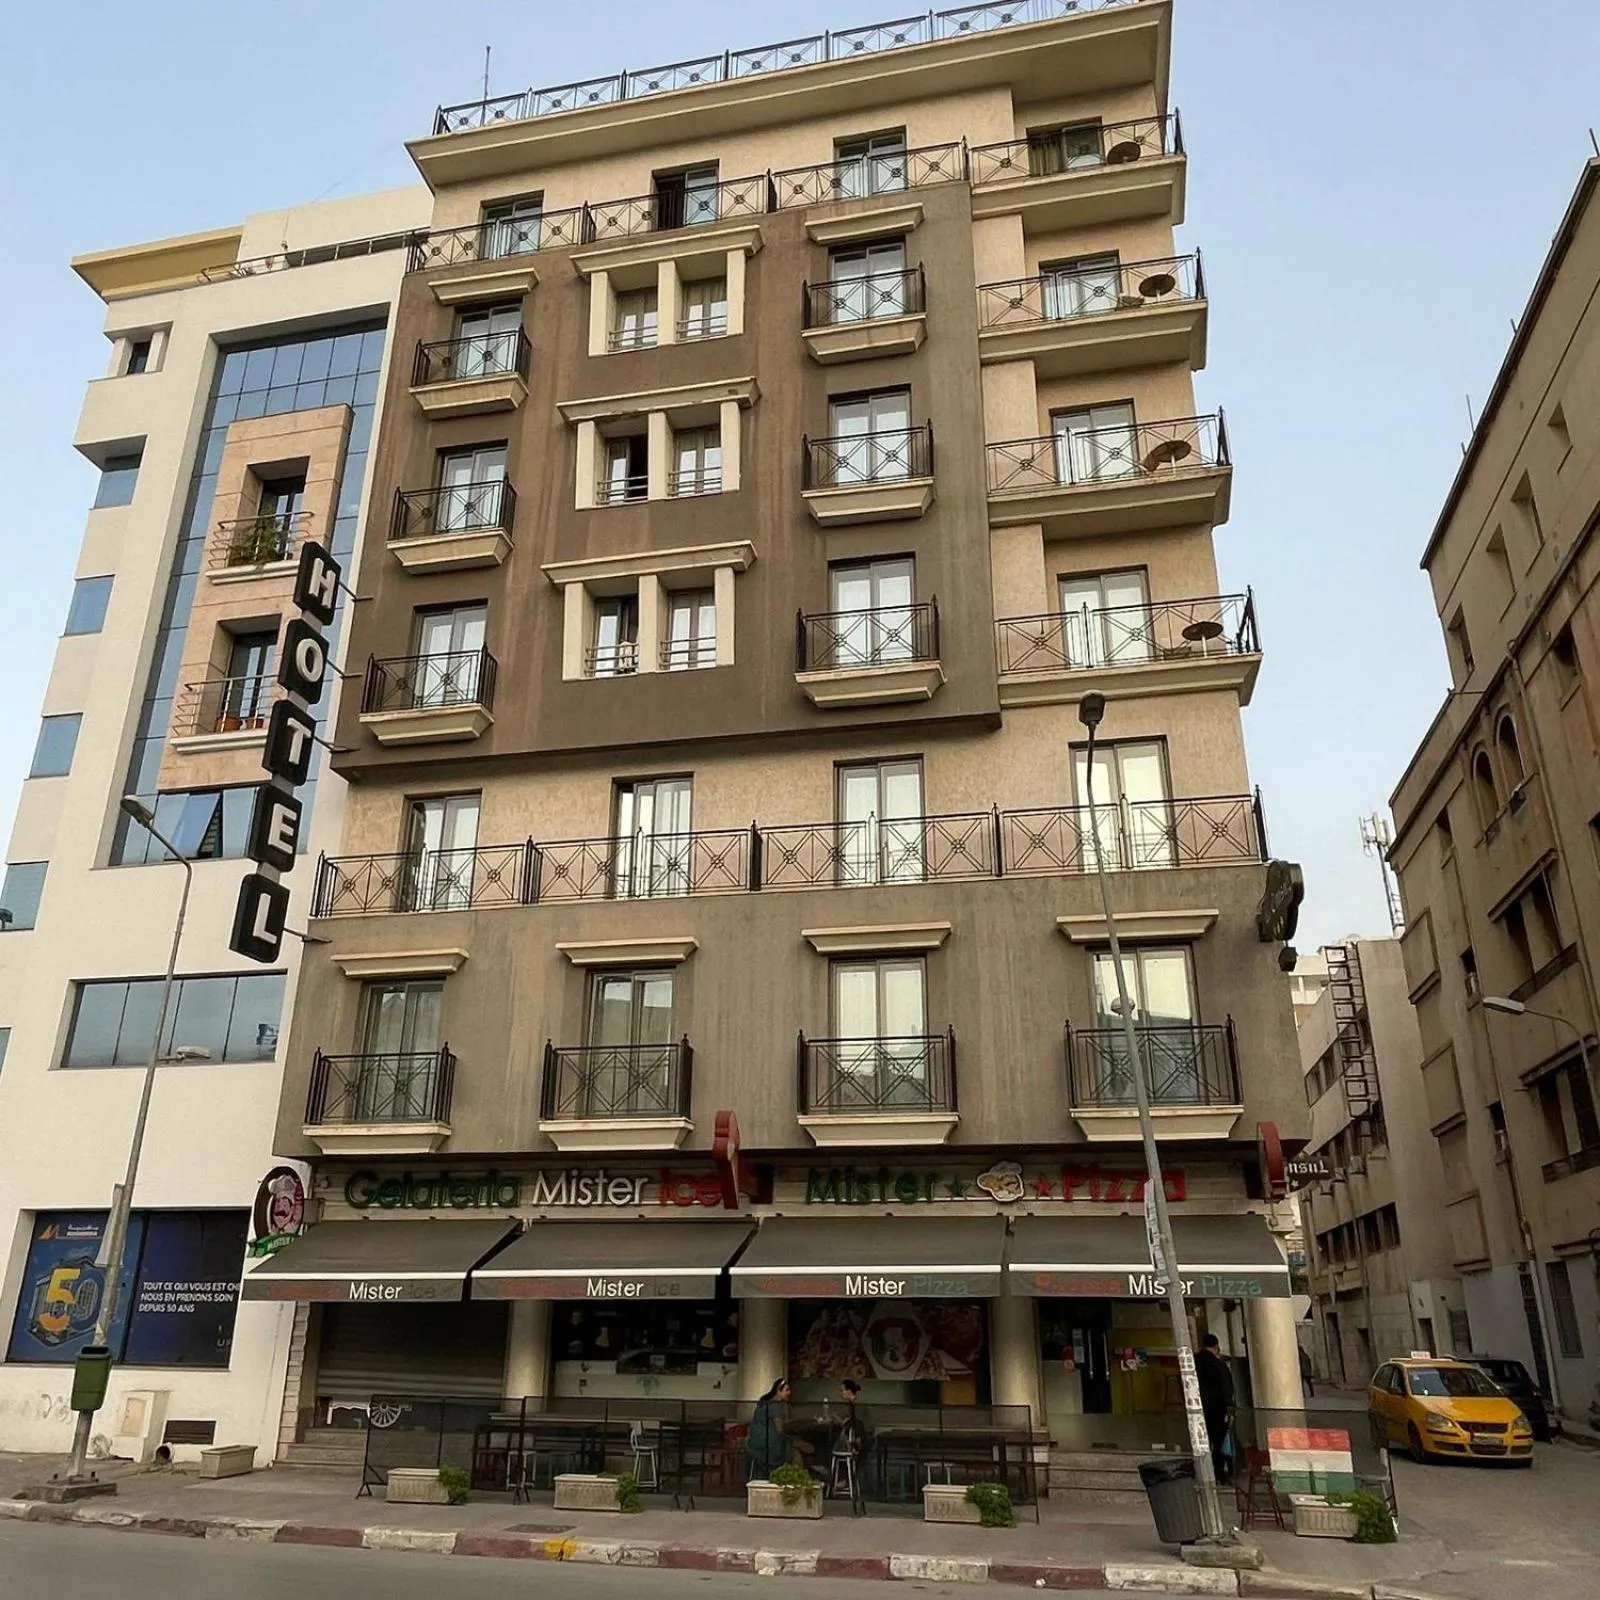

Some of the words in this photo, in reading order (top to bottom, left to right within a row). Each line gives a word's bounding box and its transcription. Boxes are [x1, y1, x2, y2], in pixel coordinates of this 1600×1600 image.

[252, 557, 337, 944] HOTEL
[344, 1170, 522, 1209] Gelateria
[531, 1169, 649, 1206] Mister
[659, 1168, 723, 1207] Ice
[805, 1166, 941, 1205] Mister
[143, 1282, 162, 1291] TOUT
[164, 1282, 172, 1291] CE
[174, 1282, 188, 1291] QUI
[190, 1283, 211, 1291] VOUS
[212, 1283, 227, 1291] EST
[349, 1281, 403, 1300] Mister
[586, 1278, 644, 1297] Mister
[845, 1275, 906, 1296] Mister
[913, 1276, 969, 1296] Pizza
[1128, 1273, 1194, 1296] Miser
[1201, 1275, 1262, 1296] Pizza
[141, 1293, 164, 1301] NOUS
[165, 1293, 175, 1301] EN
[176, 1294, 213, 1302] PRENONS
[214, 1294, 234, 1302] SOIN
[139, 1304, 165, 1312] DEPUIS
[167, 1304, 177, 1312] 50
[177, 1304, 195, 1312] ANS
